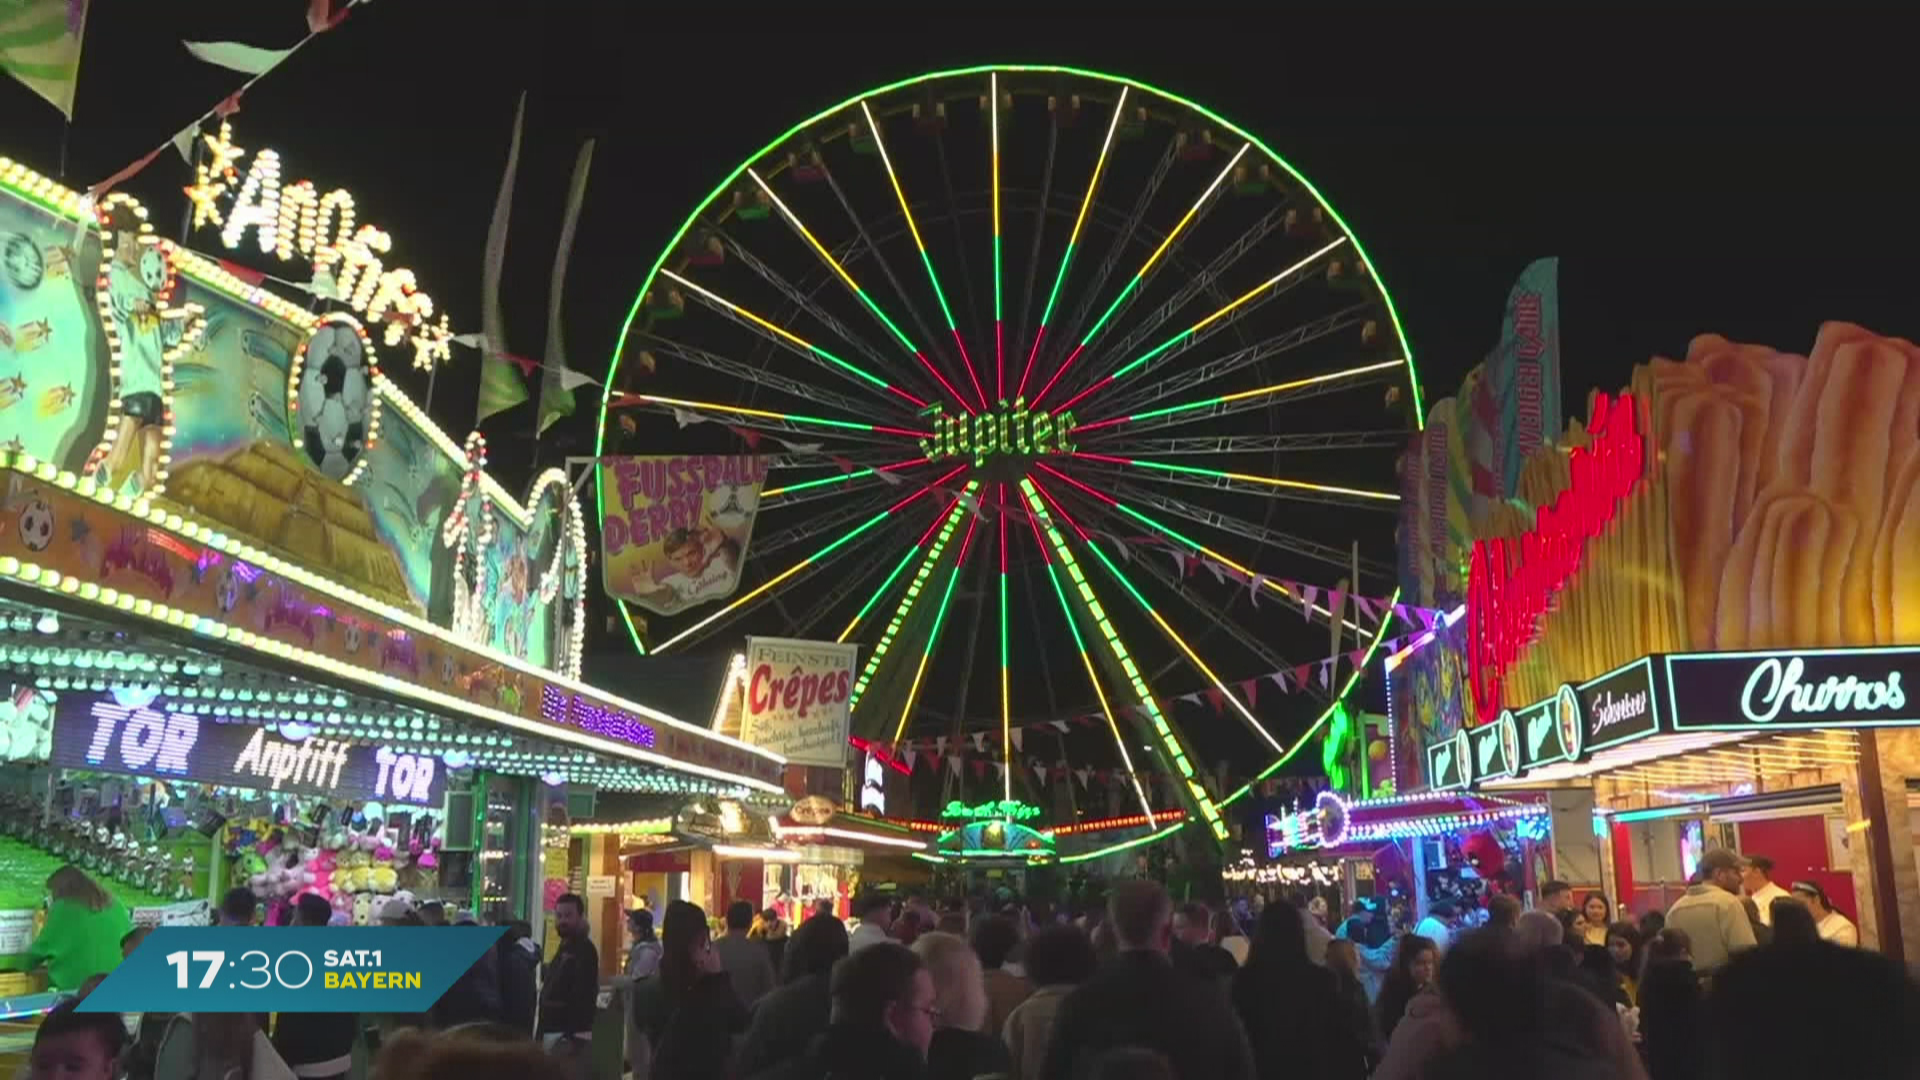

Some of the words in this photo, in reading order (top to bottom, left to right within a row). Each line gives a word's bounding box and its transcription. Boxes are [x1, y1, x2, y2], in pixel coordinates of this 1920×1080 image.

[918, 396, 1077, 467] Jupiter
[614, 455, 768, 511] FUSSBALL
[605, 492, 704, 556] DERBY
[758, 647, 848, 667] FEINSTE
[750, 664, 850, 718] Crêpes
[1741, 657, 1905, 722] Churros
[86, 702, 199, 775] TOR
[233, 727, 350, 790] Anpfiff
[374, 748, 434, 801] TOR
